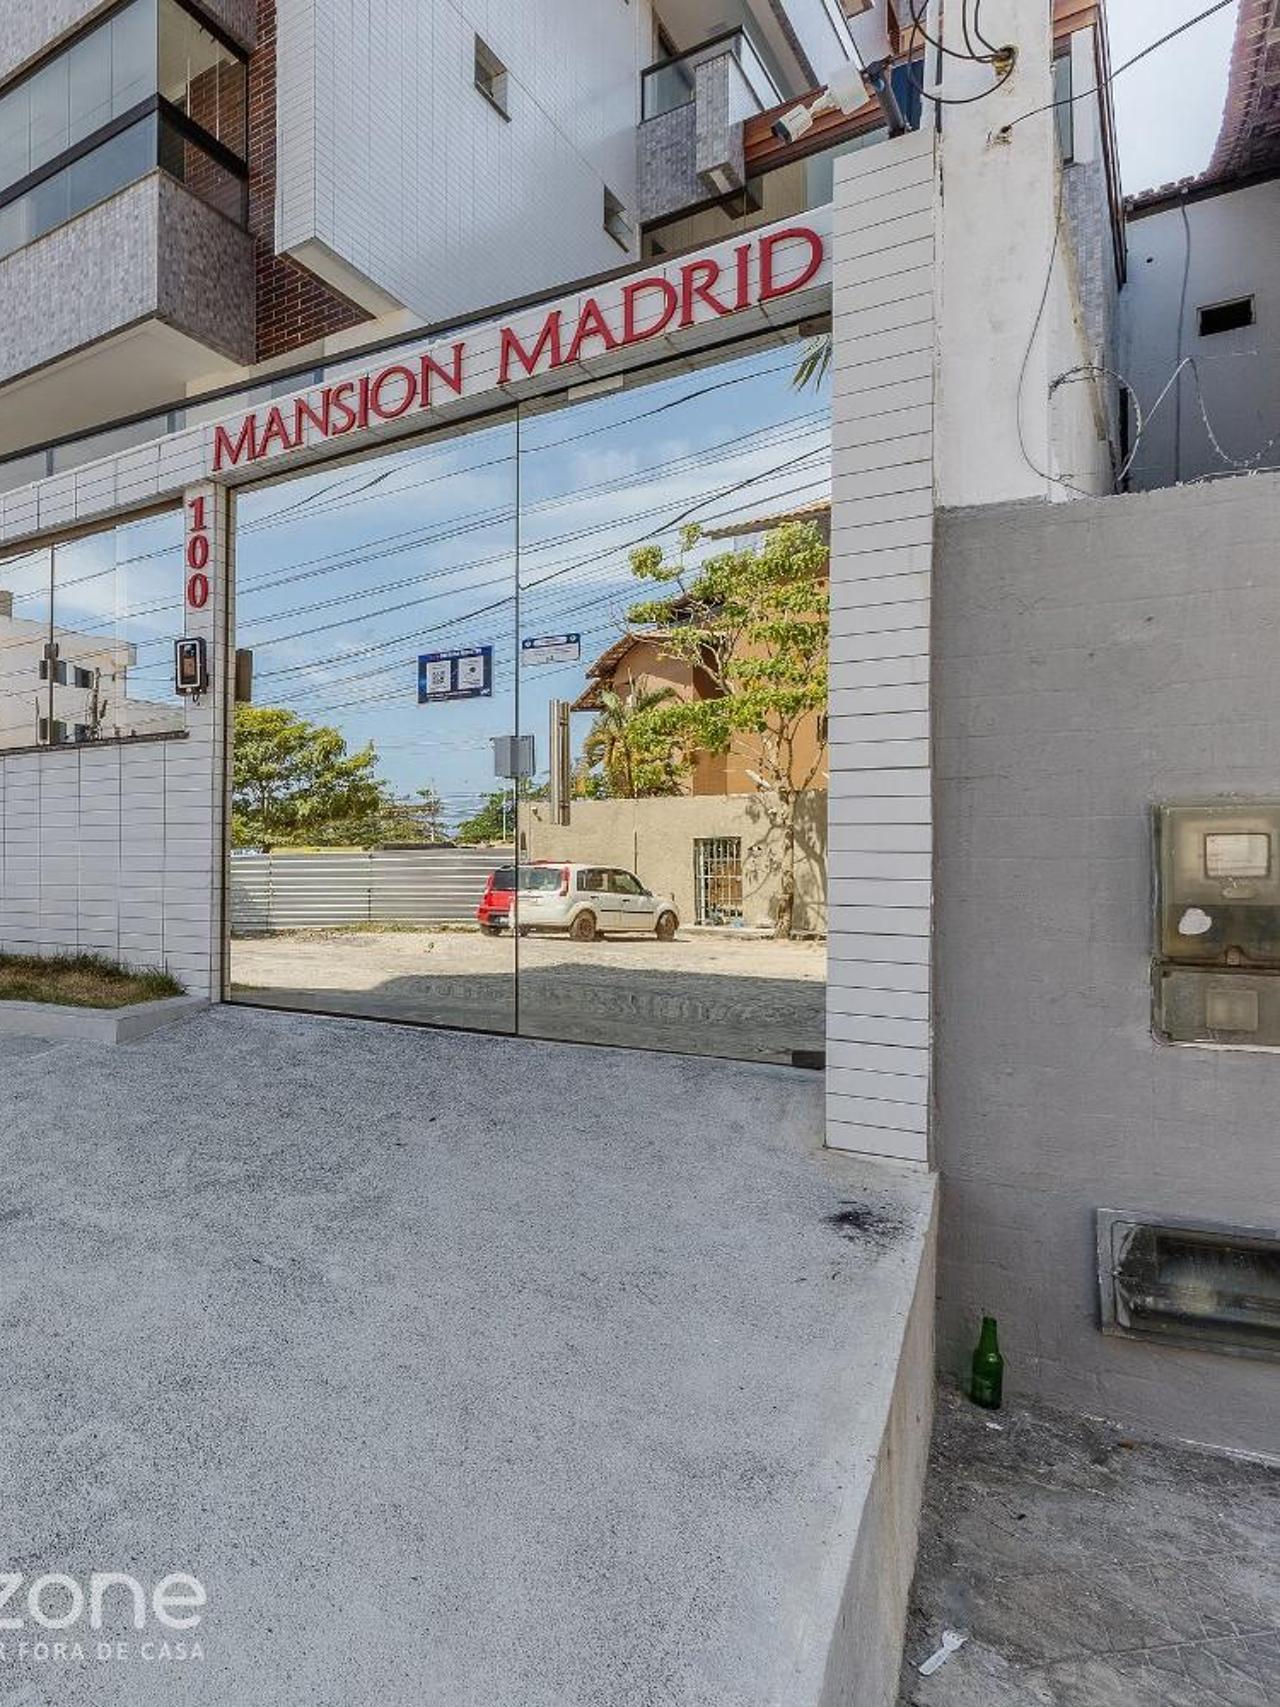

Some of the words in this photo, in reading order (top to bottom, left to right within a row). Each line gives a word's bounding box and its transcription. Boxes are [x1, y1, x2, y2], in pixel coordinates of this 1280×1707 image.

[213, 343, 465, 471] MANSION
[496, 227, 823, 384] MADRID
[187, 496, 209, 608] 100
